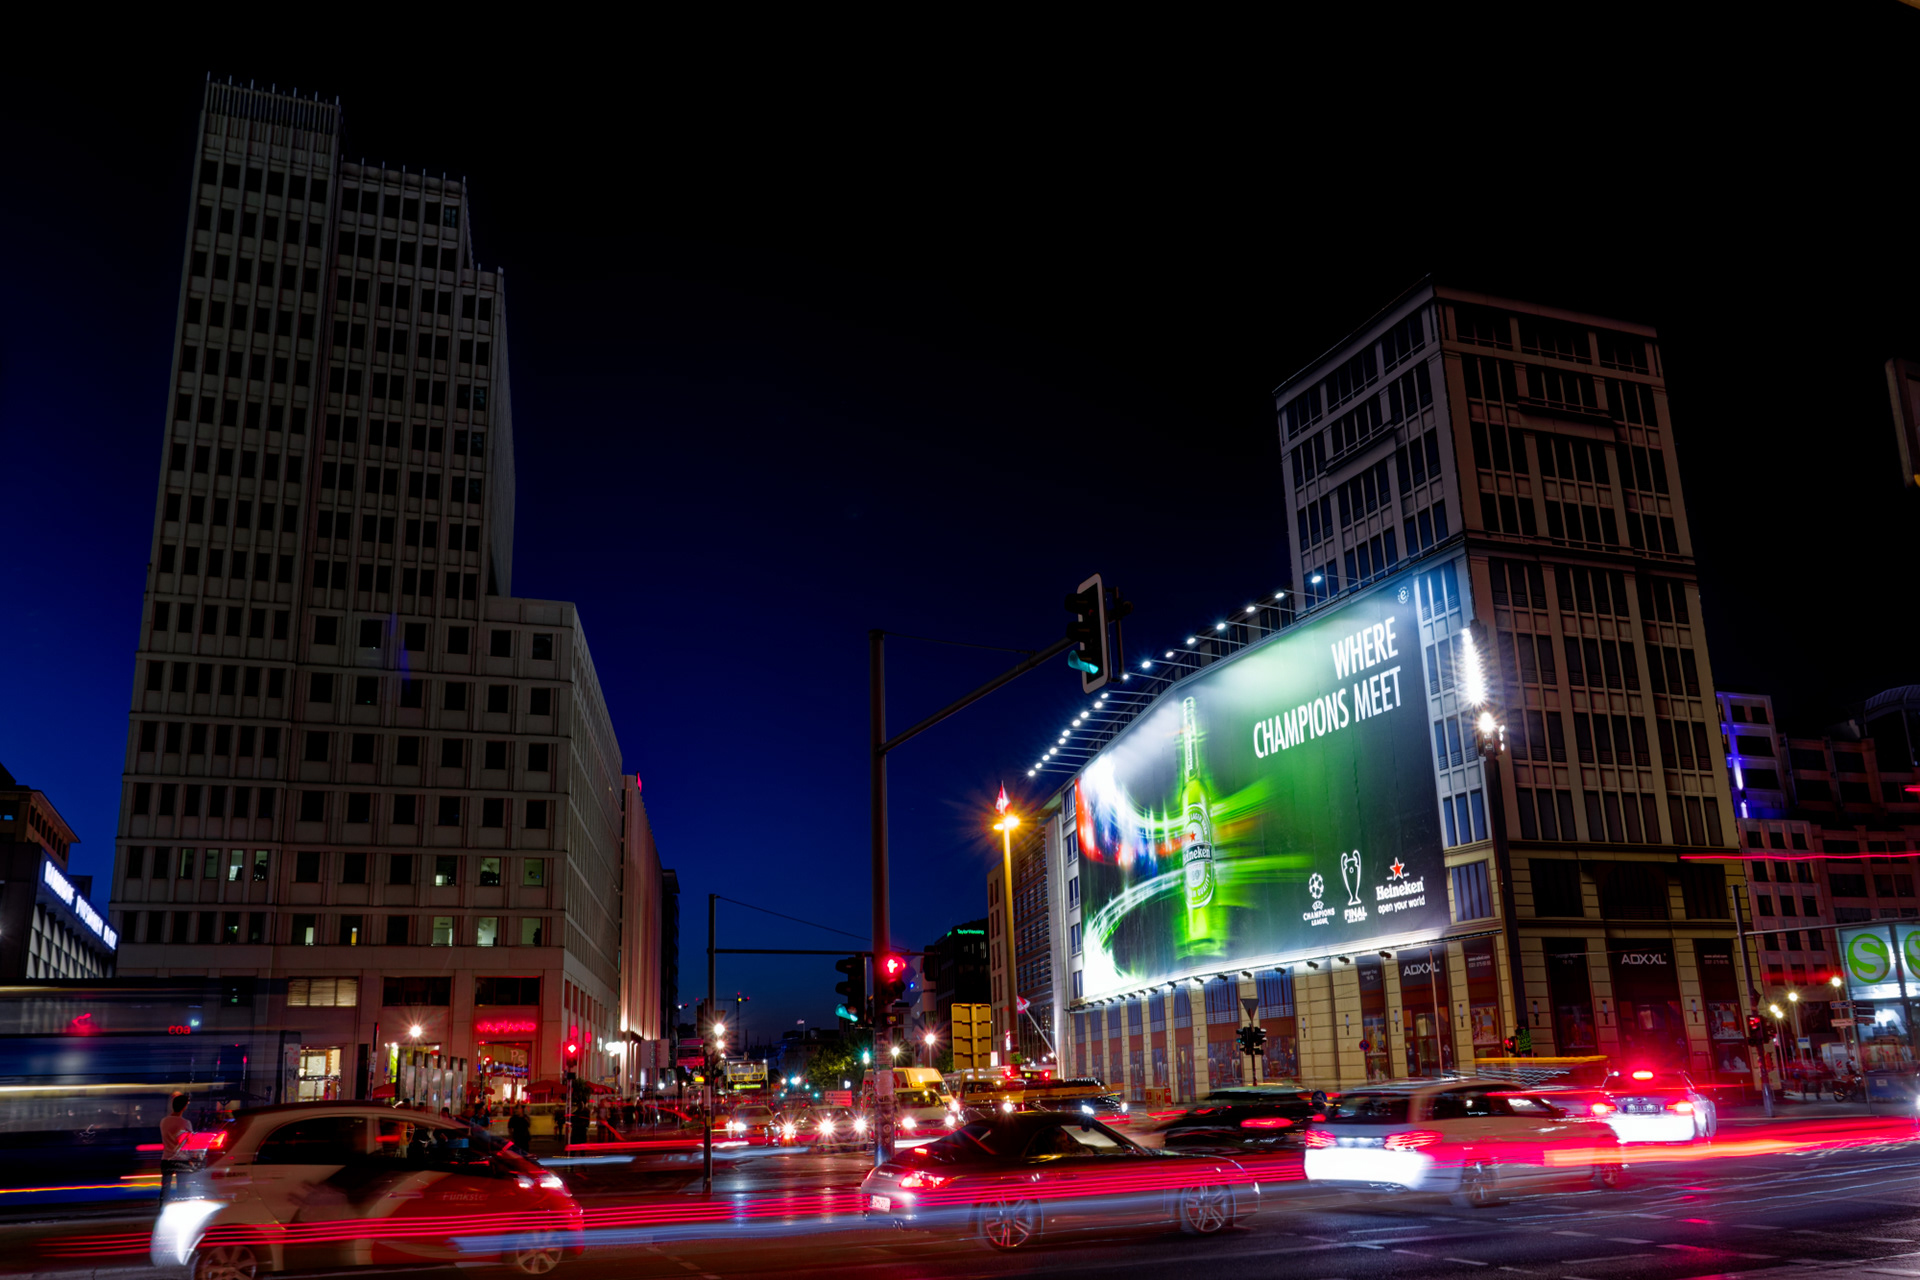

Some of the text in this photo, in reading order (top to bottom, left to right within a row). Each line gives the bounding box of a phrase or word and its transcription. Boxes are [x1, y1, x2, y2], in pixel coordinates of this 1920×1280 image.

[1331, 616, 1398, 680] WHERE
[1253, 665, 1401, 759] CHAMPIONS MEET
[1375, 880, 1425, 900] Heineken
[1377, 895, 1426, 915] open your world
[1302, 907, 1336, 921] CHAMPIONS
[1344, 906, 1368, 920] FINAL
[1621, 953, 1666, 966] ADXXL
[1403, 962, 1440, 977] ADXXL
[168, 1025, 191, 1035] coa
